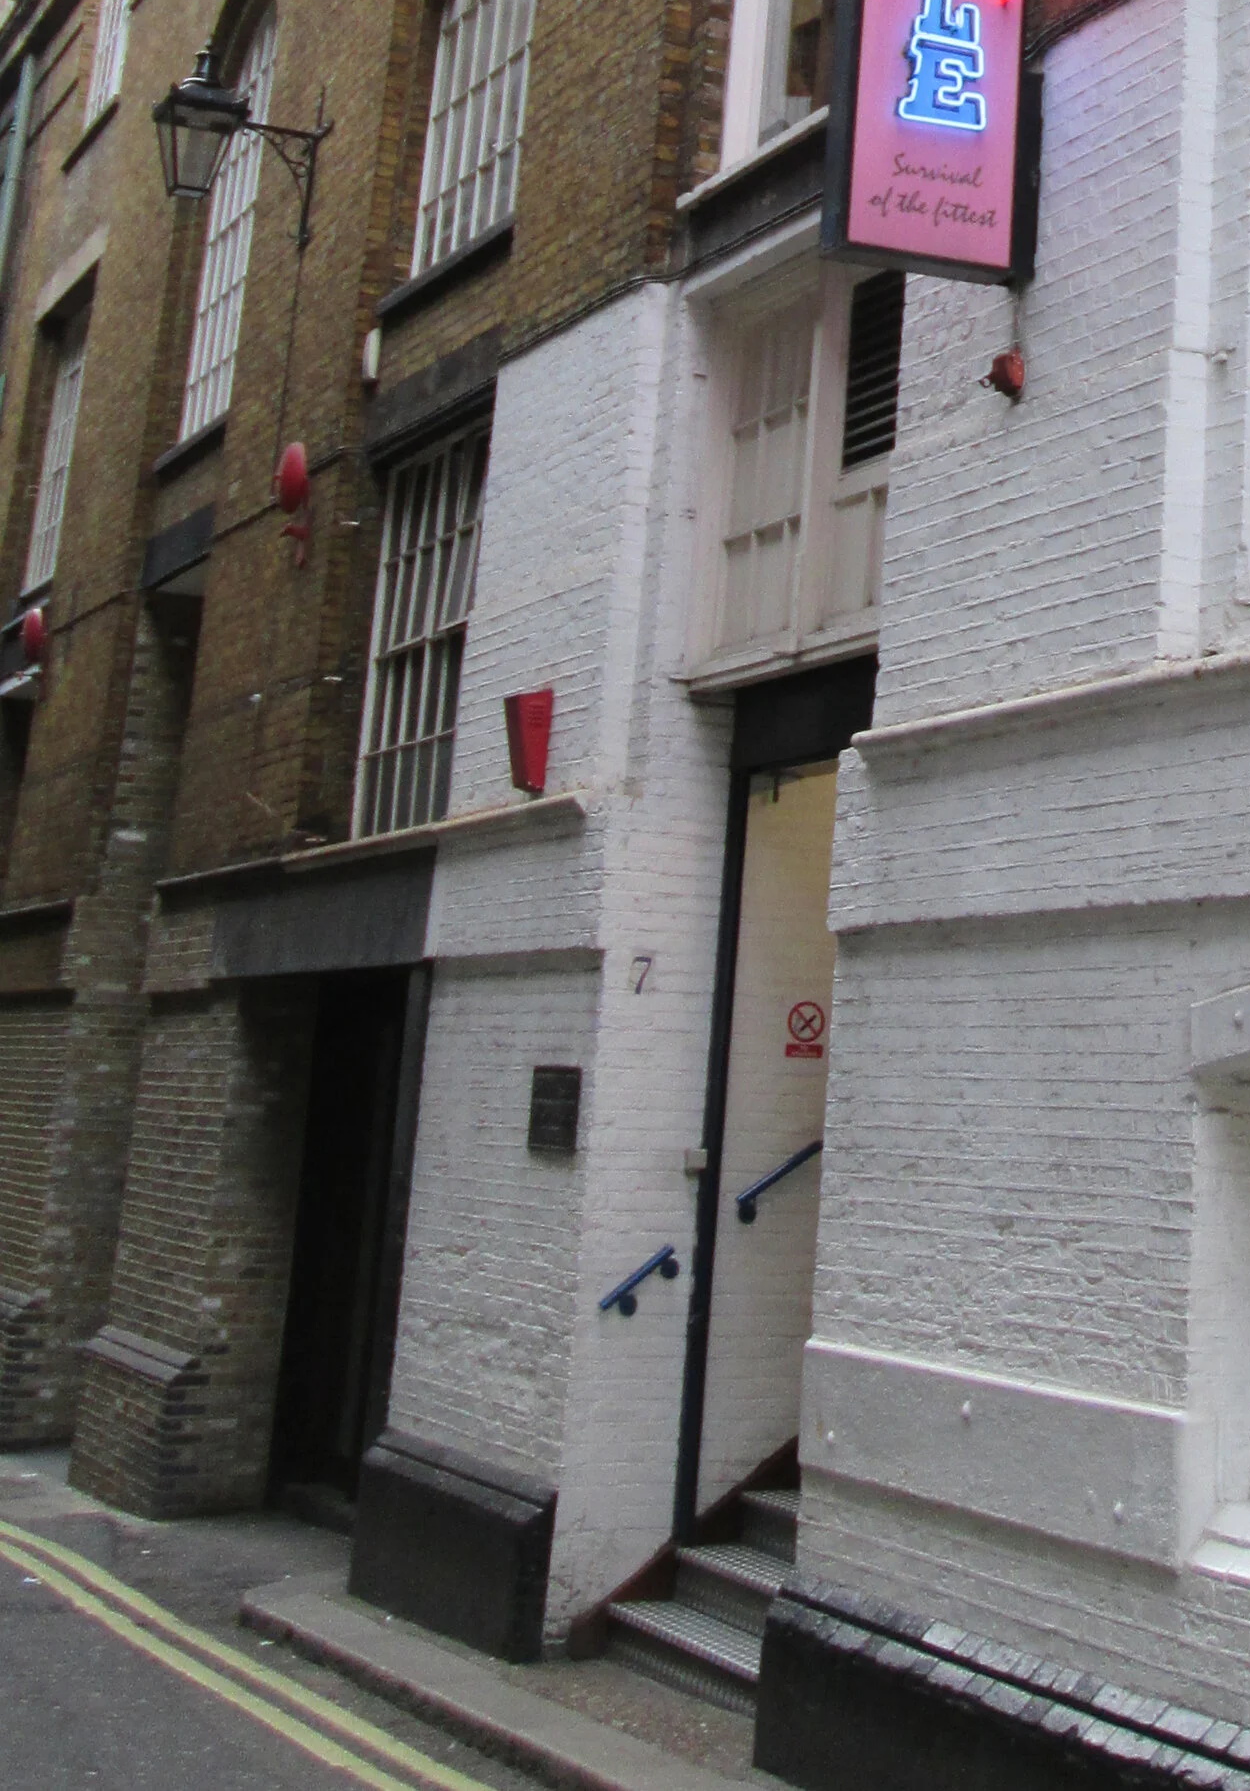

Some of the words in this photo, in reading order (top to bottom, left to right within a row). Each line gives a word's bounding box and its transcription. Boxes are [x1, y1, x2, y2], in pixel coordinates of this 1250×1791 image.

[892, 153, 982, 187] Survival
[868, 187, 893, 217] of
[897, 190, 927, 214] the
[933, 196, 996, 228] fittest
[631, 956, 652, 995] 7
